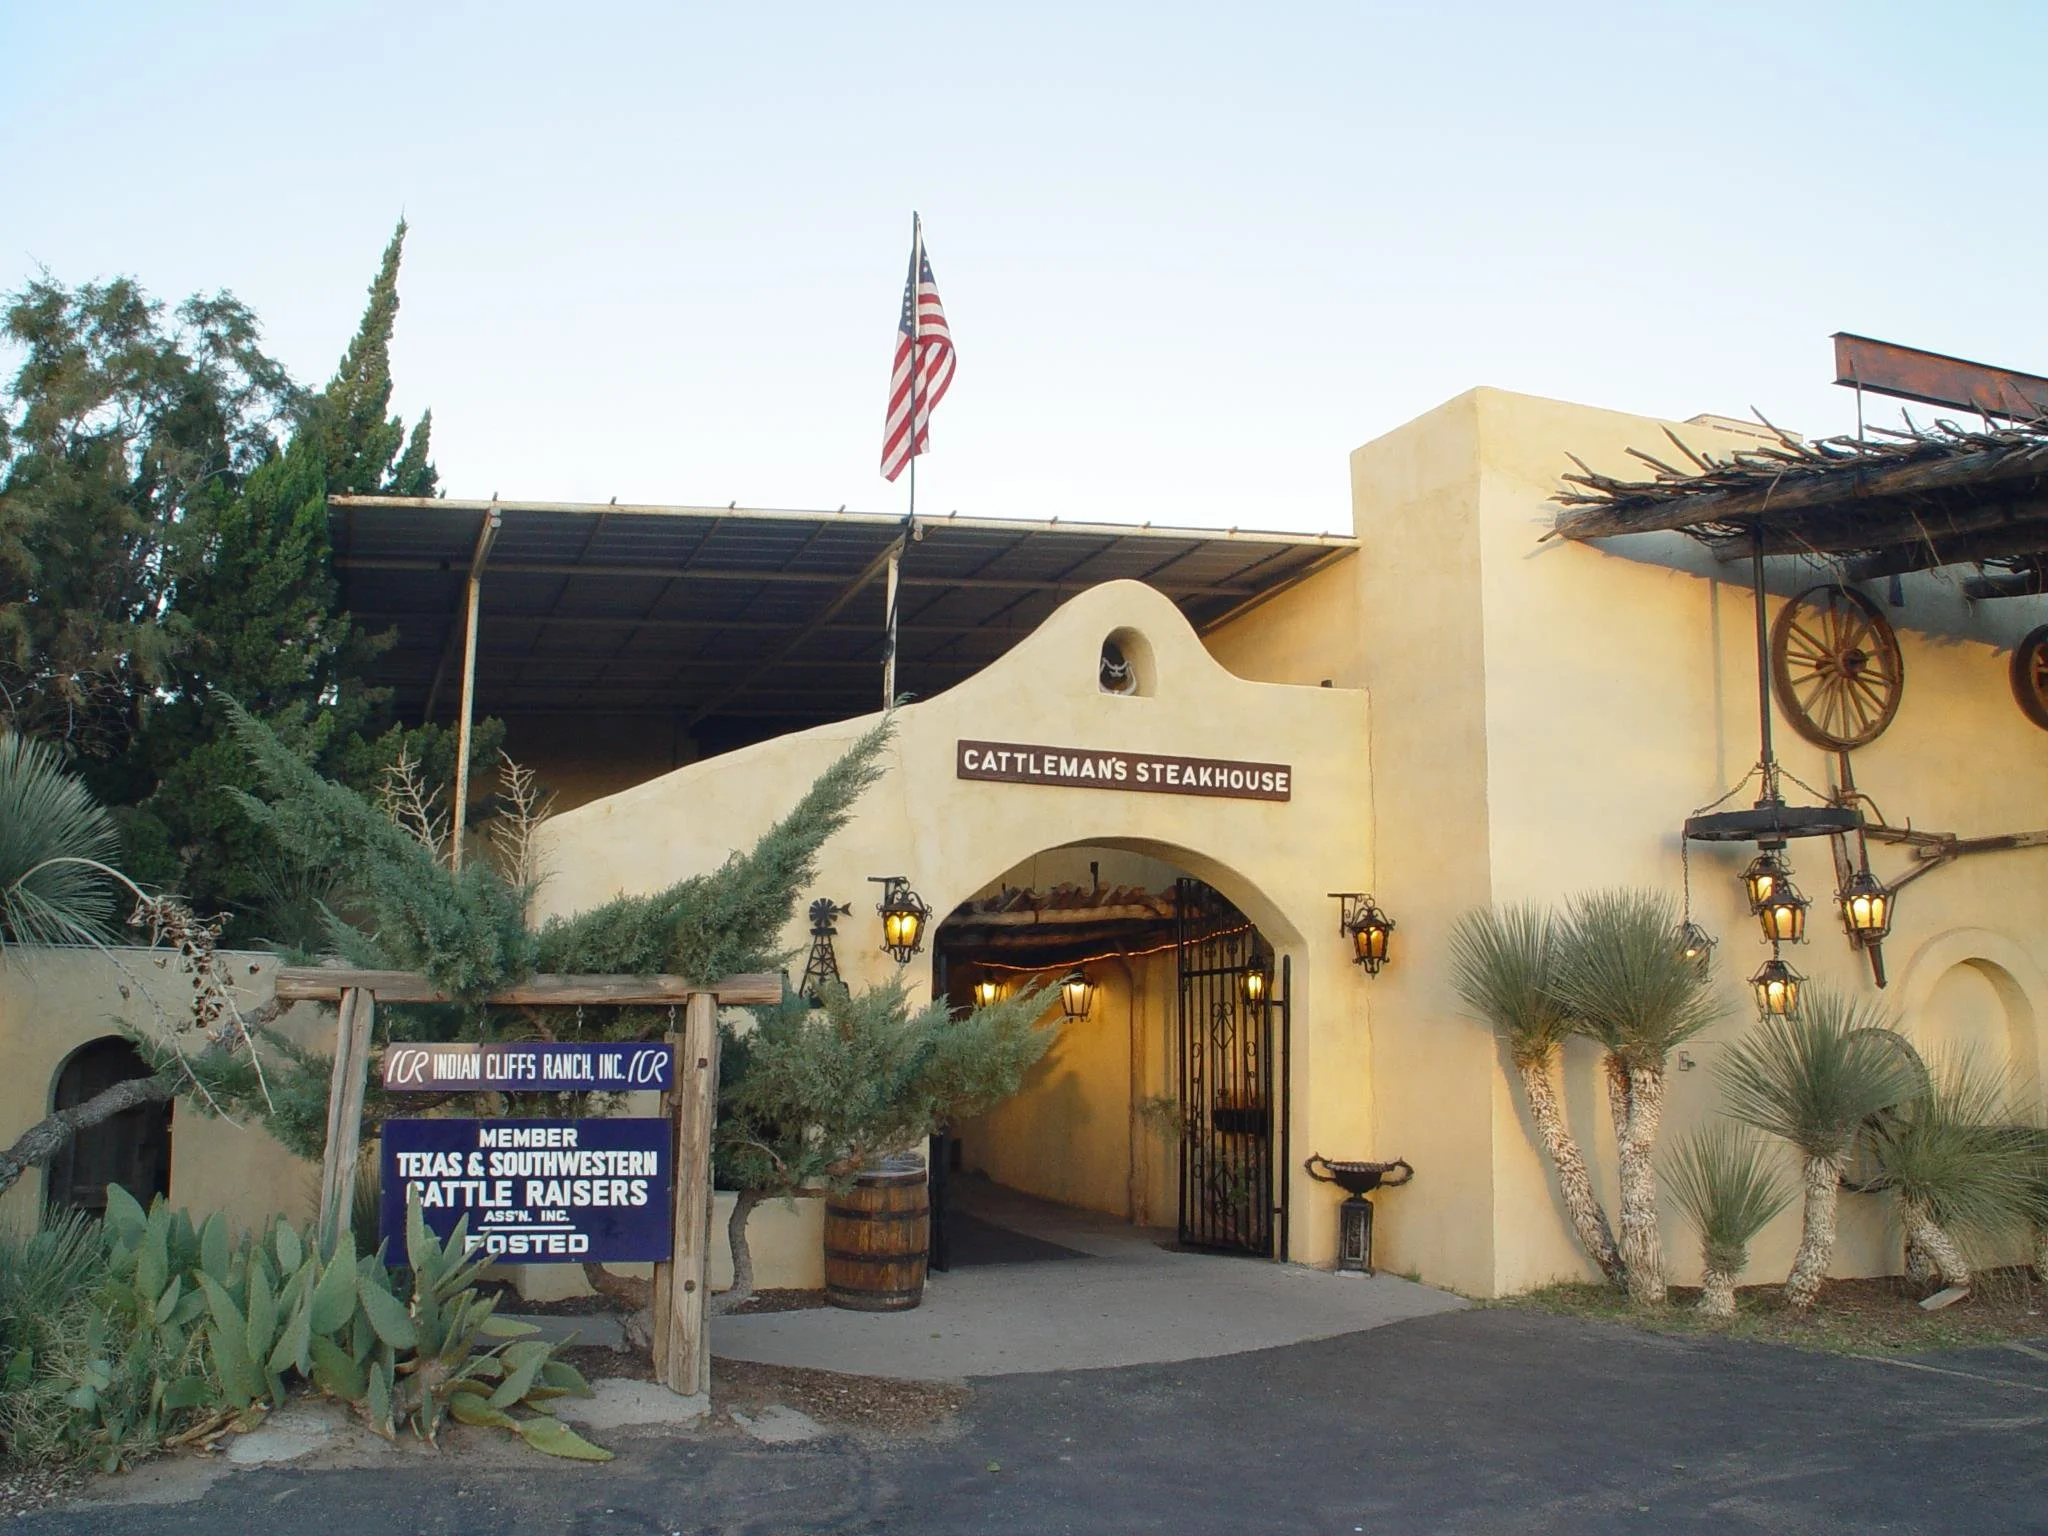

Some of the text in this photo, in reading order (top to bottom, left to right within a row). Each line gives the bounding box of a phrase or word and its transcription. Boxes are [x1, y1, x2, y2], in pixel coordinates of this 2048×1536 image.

[963, 748, 1290, 793] CATTLEMAN'S STEAKHOUSE
[433, 1053, 480, 1080] INDIAN
[486, 1053, 537, 1080] CLIFFS
[542, 1053, 595, 1082] RANCH,
[598, 1053, 626, 1080] INC.
[479, 1128, 579, 1148] MEMBER
[396, 1150, 658, 1177] TEXAS & SOUTHWESTERN
[526, 1179, 649, 1207] RAISERS
[483, 1210, 570, 1223] ASS'N. INC.
[464, 1233, 590, 1254] POSTED
